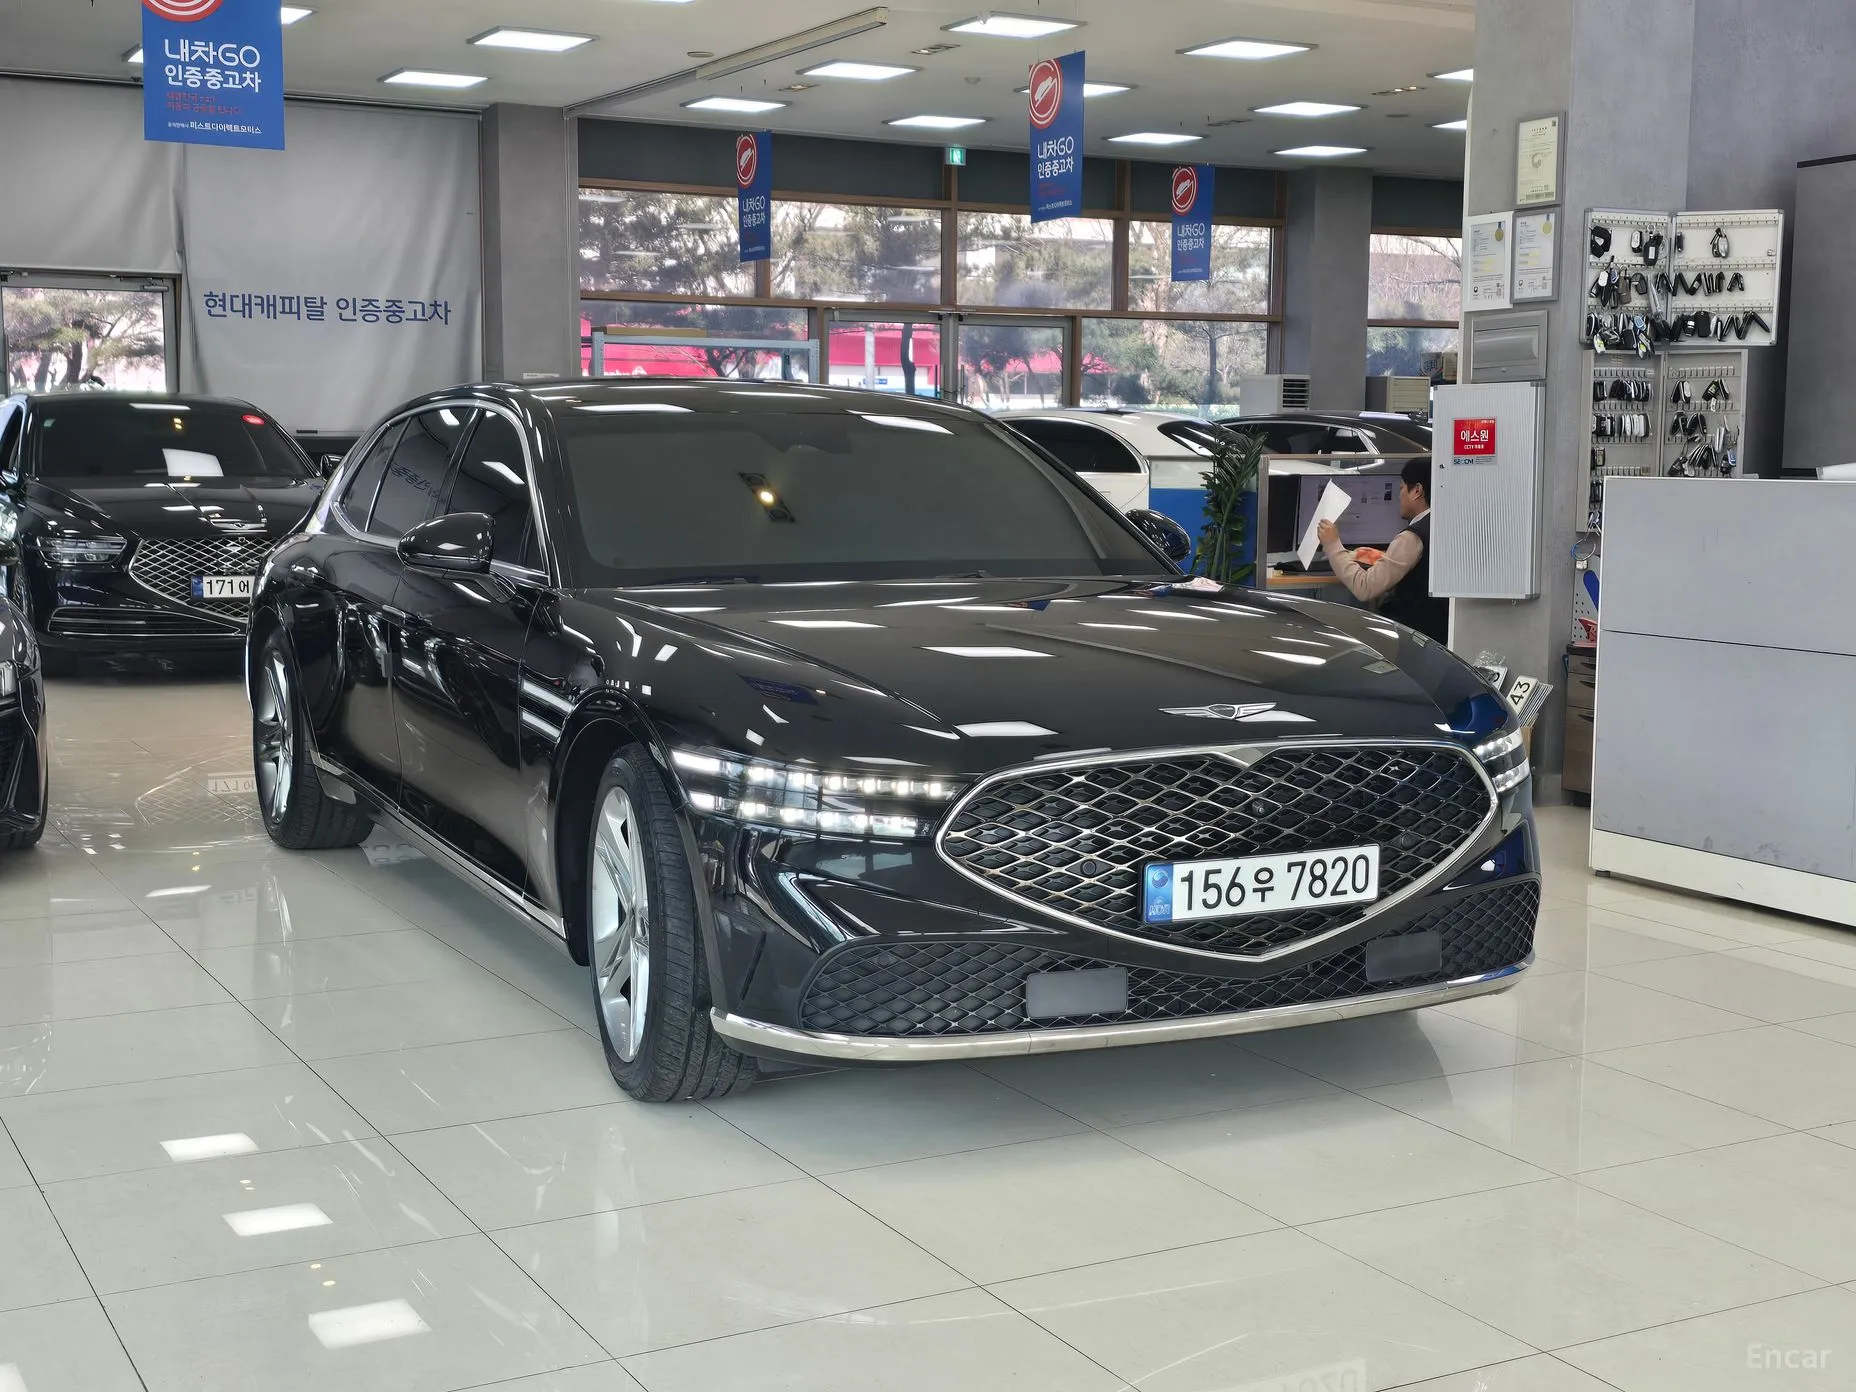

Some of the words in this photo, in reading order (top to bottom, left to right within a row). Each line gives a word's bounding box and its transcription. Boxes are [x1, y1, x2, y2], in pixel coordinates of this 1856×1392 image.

[164, 39, 261, 68] 내차GO
[164, 64, 261, 93] 인증중고차
[1037, 136, 1074, 159] 내차GO
[1037, 156, 1074, 179] 인증중고차
[203, 291, 327, 322] 현대캐피탈
[335, 297, 452, 325] 인증중고차
[1460, 429, 1489, 442] 에스원
[206, 579, 250, 595] 171어
[1180, 866, 1275, 911] 156우
[1286, 853, 1370, 901] 7820
